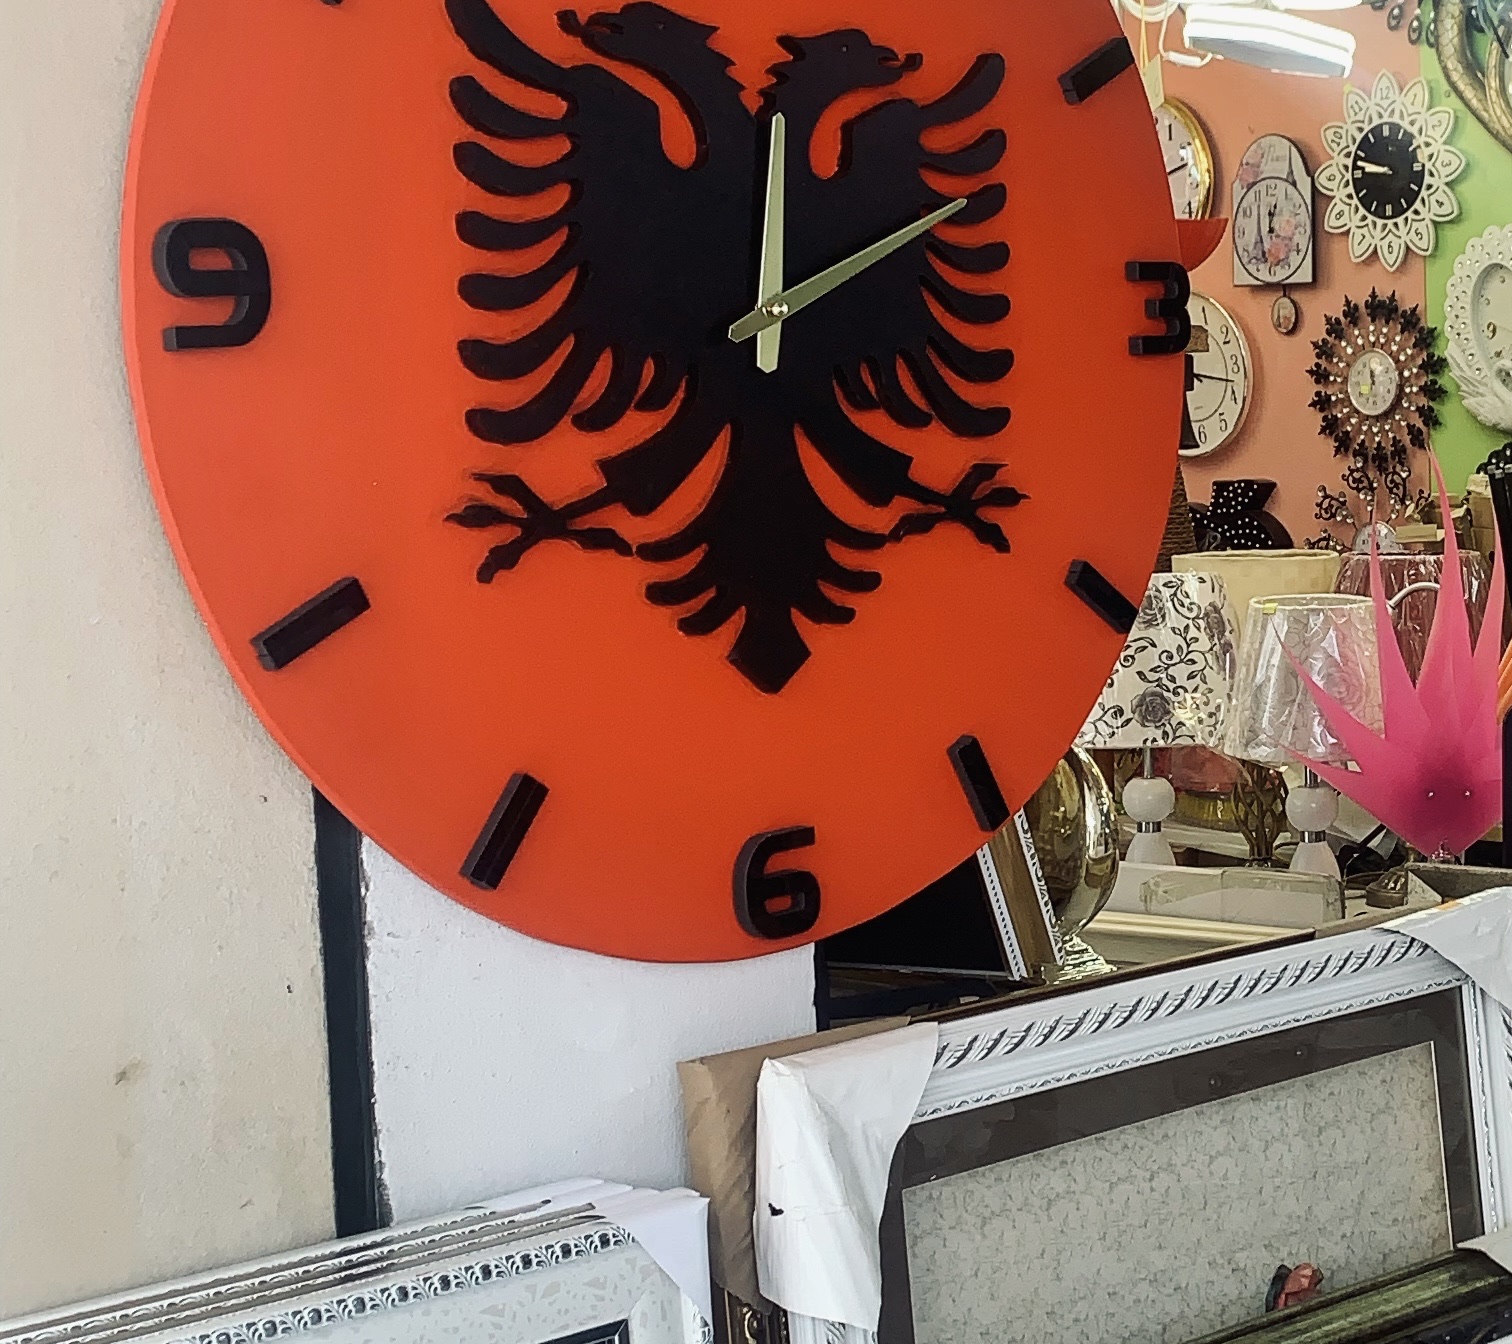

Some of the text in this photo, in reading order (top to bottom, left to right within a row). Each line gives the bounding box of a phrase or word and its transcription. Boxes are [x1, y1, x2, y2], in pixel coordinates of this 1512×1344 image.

[1380, 88, 1391, 100] 12
[1350, 104, 1363, 117] 11
[1168, 123, 1173, 141] 1
[1432, 120, 1442, 131] 2
[1331, 130, 1343, 147] 10
[1441, 159, 1452, 168] 3
[1265, 183, 1277, 197] 12
[1182, 201, 1194, 218] 4
[1435, 199, 1445, 209] 4
[1334, 210, 1345, 220] 8
[1357, 233, 1366, 246] 7
[1415, 229, 1424, 241] 5
[1387, 240, 1394, 255] 6
[151, 215, 273, 352] 9
[1125, 261, 1191, 355] 3
[1202, 306, 1208, 325] 1
[1220, 324, 1231, 345] 2
[1487, 322, 1497, 340] 9
[1230, 354, 1240, 375] 3
[1230, 386, 1238, 405] 4
[1218, 412, 1228, 432] 5
[1198, 424, 1208, 444] 6
[732, 825, 821, 941] 6
